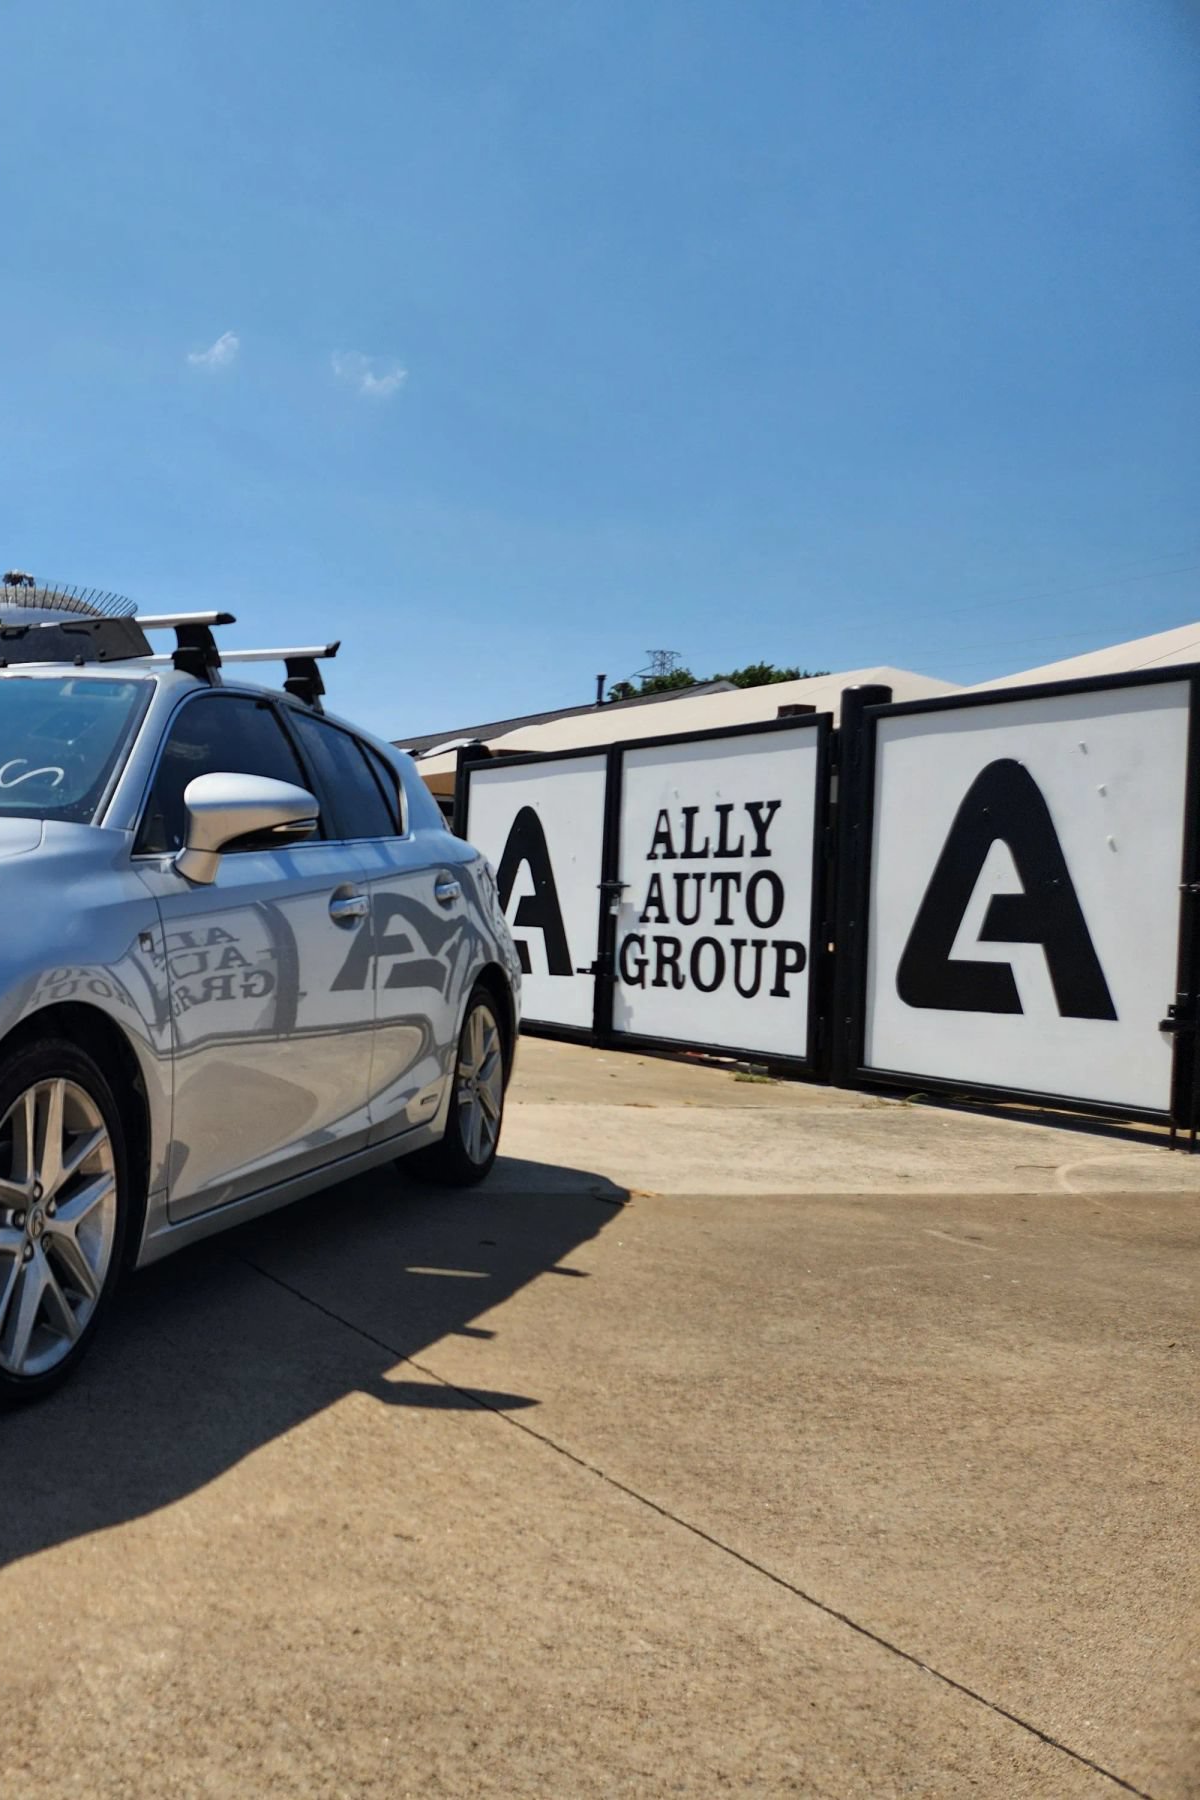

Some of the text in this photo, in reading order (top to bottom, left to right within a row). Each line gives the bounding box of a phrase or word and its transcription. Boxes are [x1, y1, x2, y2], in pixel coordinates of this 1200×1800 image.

[646, 799, 782, 860] ALLY
[639, 869, 785, 929] AUTO
[619, 933, 807, 999] GROUP
